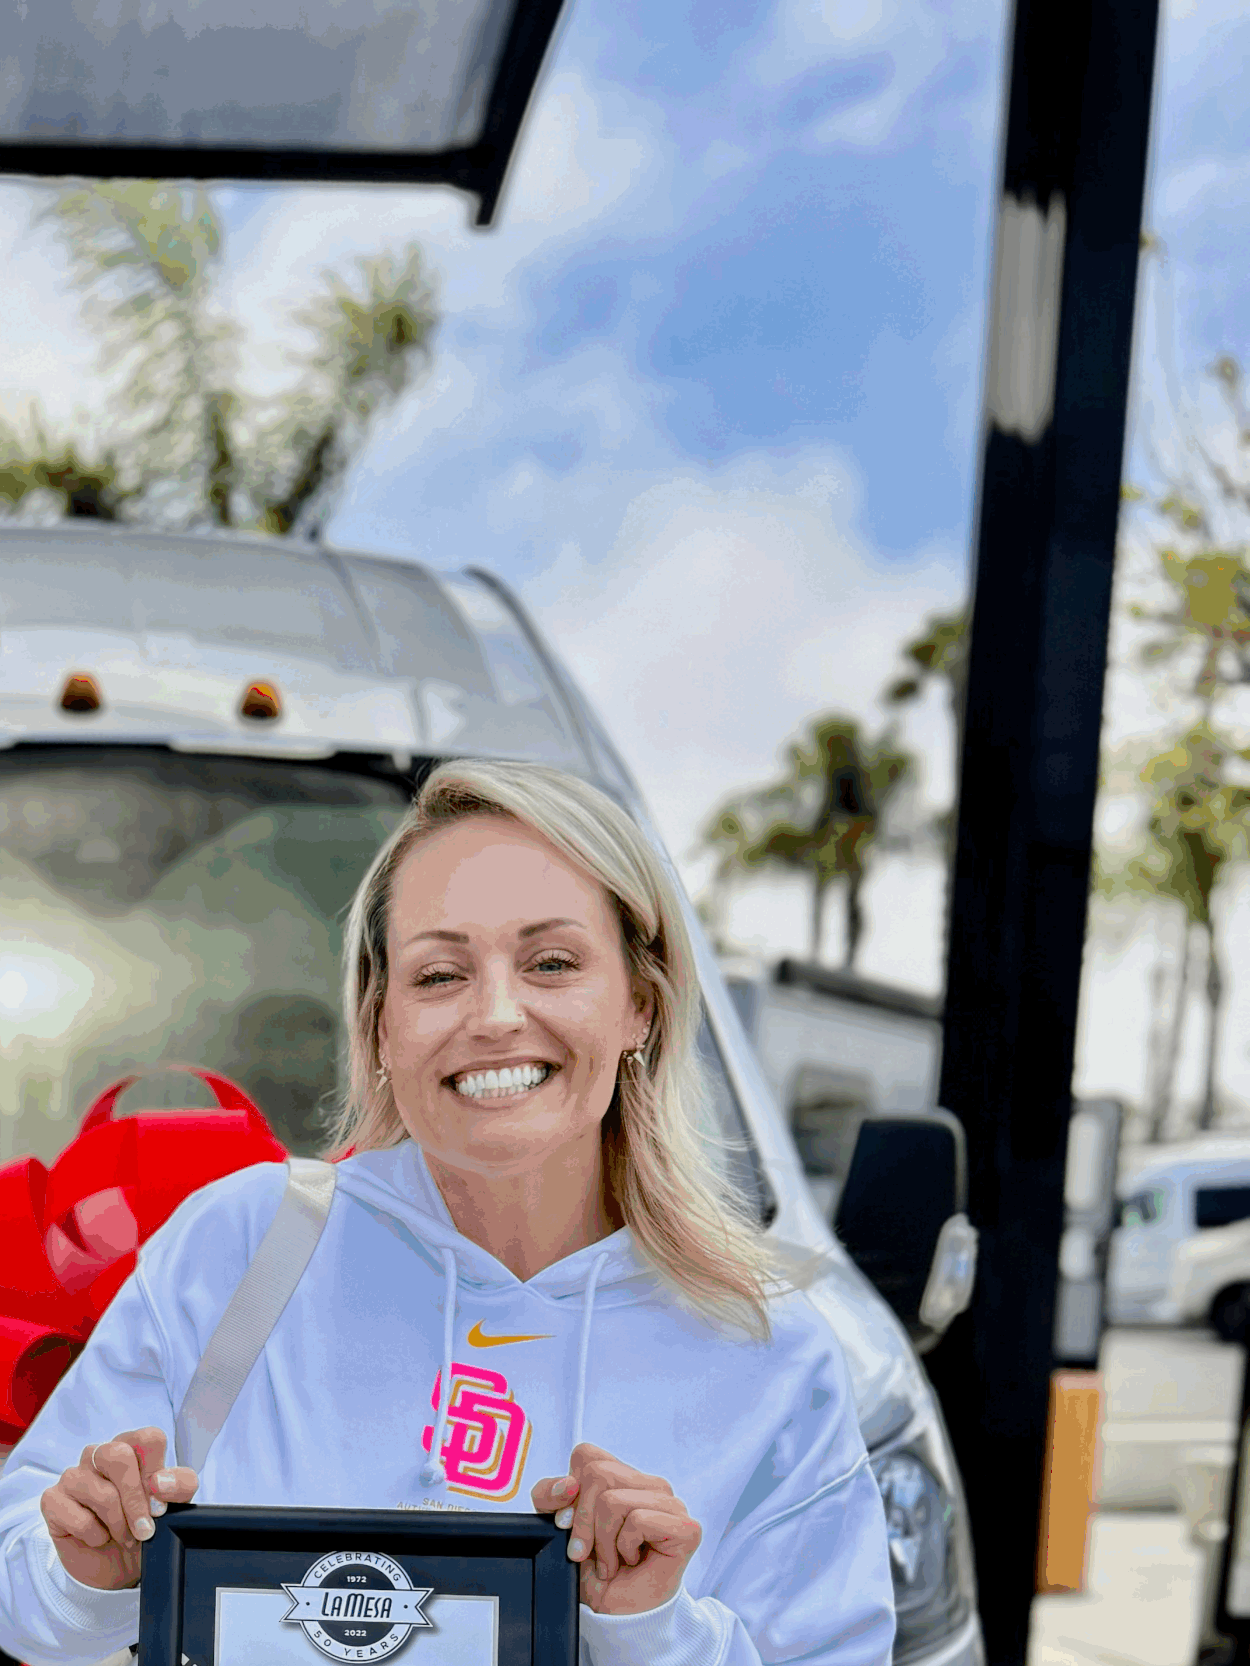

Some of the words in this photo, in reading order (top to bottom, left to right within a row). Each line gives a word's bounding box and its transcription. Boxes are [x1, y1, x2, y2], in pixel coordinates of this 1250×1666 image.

[314, 1552, 402, 1582] CELEBRATING
[346, 1575, 367, 1583] 1972
[344, 1629, 367, 1637] 2022
[313, 1630, 332, 1647] 50
[343, 1633, 399, 1658] YEARS
